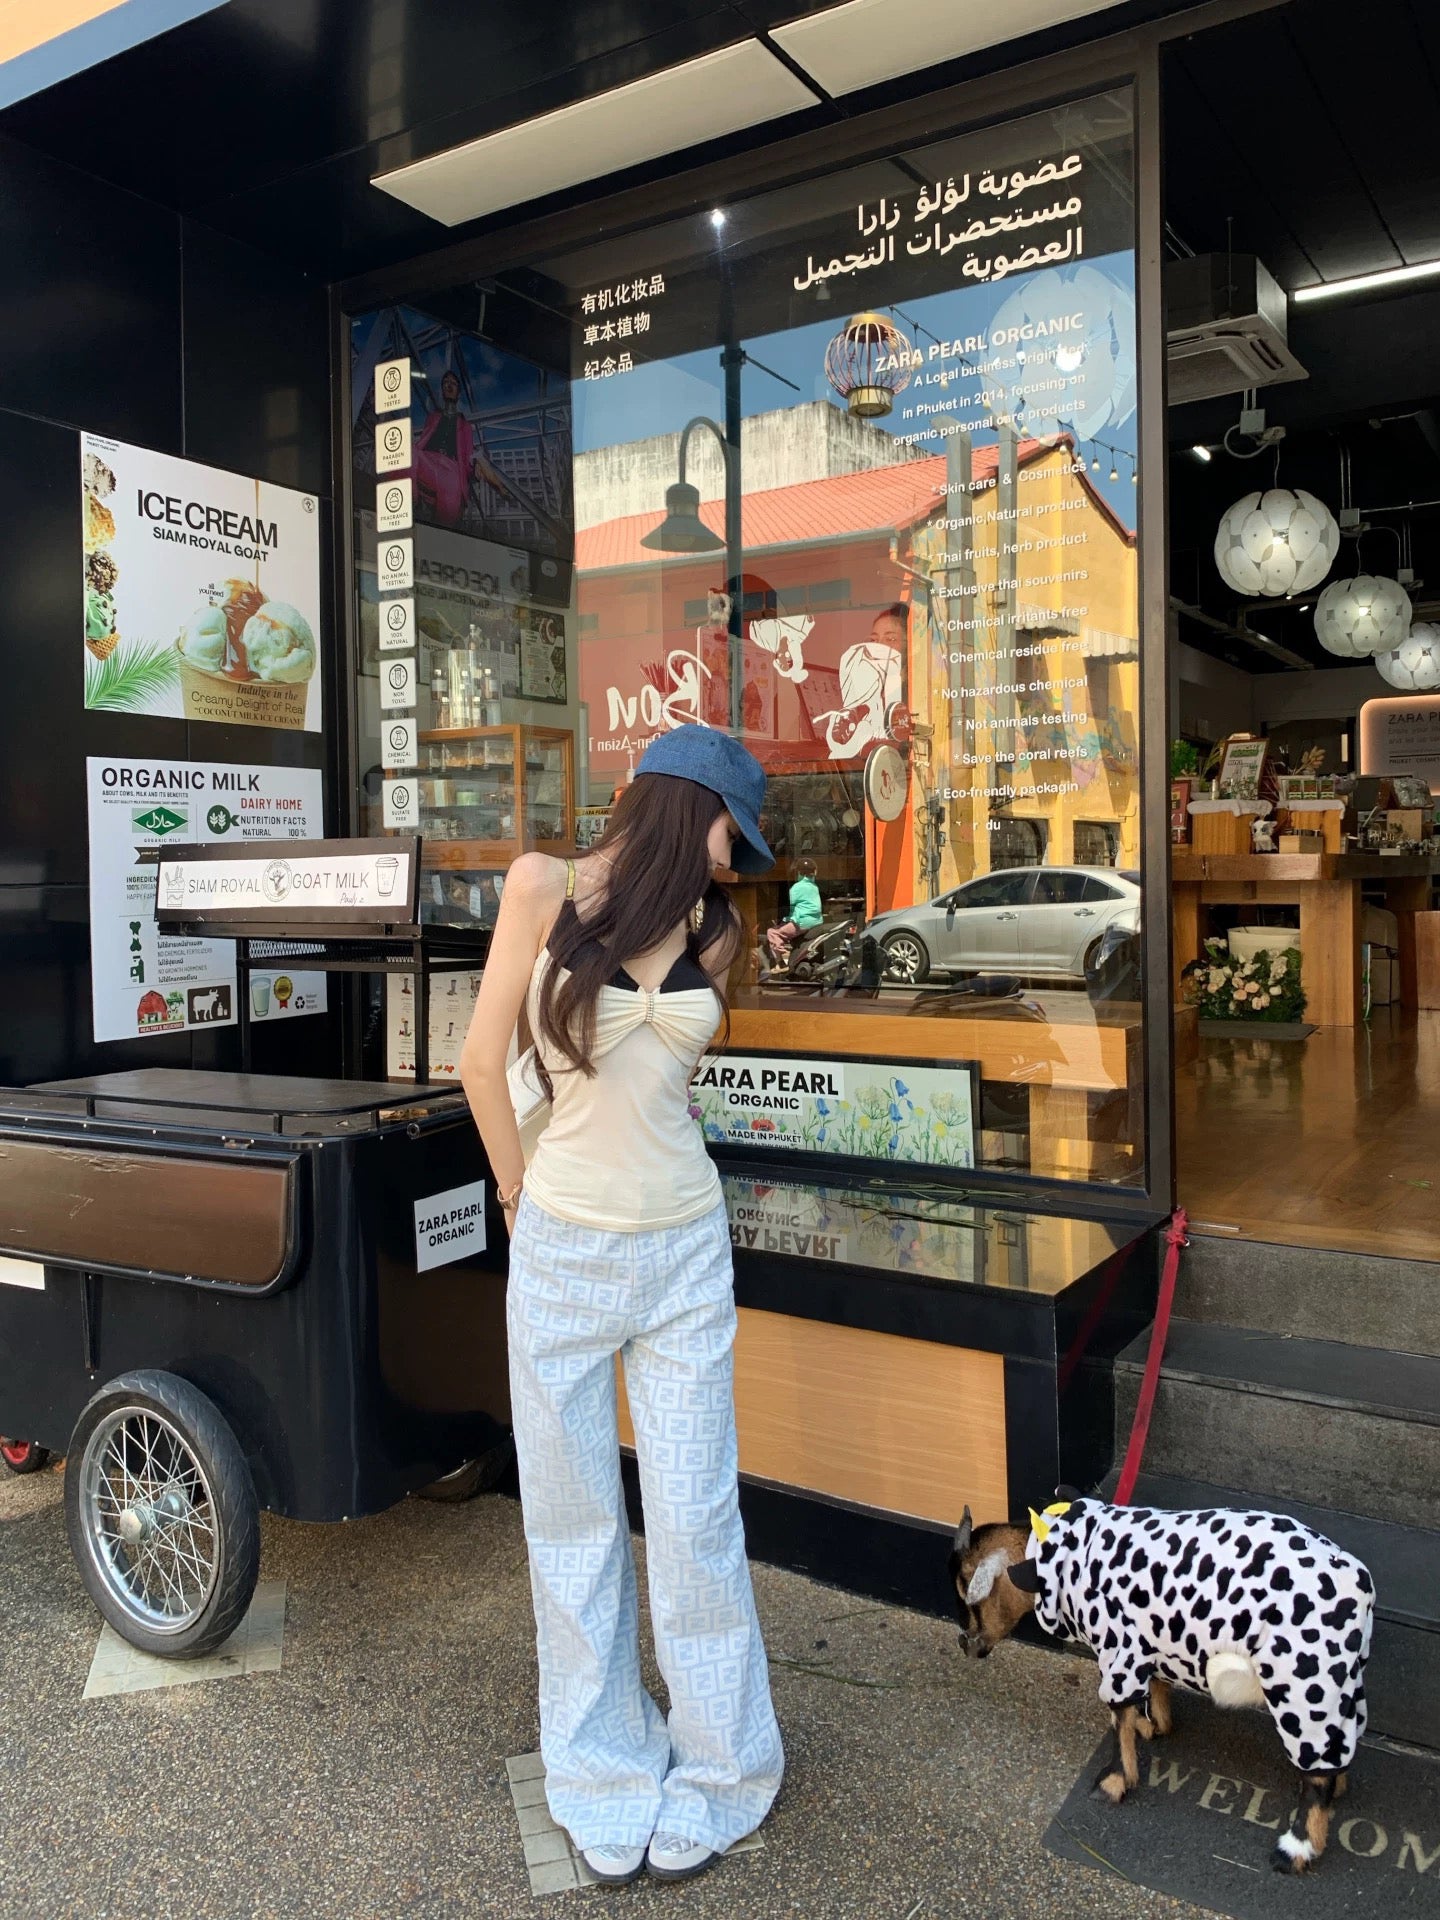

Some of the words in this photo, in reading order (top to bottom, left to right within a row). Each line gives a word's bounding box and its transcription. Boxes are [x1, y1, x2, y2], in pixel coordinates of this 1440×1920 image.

[914, 173, 970, 223] لؤلؤ
[858, 198, 900, 237] زارا
[906, 197, 1082, 256] مستحضرات
[793, 235, 895, 291] التجميل
[962, 226, 1083, 282] العضوية
[580, 273, 665, 315] 有机化妆品
[583, 311, 651, 346] 草本植物
[874, 348, 924, 373] ZARA
[929, 334, 988, 361] PEARL
[991, 312, 1084, 346] ORGANIC
[584, 352, 633, 381] 纪念品
[914, 376, 923, 388] A
[926, 369, 959, 385] Local
[961, 356, 1016, 377] business
[902, 407, 913, 420] in
[916, 398, 958, 417] Phuket
[960, 395, 971, 407] in
[1011, 377, 1066, 397] focusing
[1070, 374, 1085, 385] on
[893, 430, 937, 447] organic
[940, 418, 993, 438] personal
[1027, 400, 1086, 419] products
[939, 481, 966, 496] Skin
[968, 476, 996, 492] care
[1002, 473, 1012, 486] &
[1018, 462, 1087, 483] Cosmetics
[137, 489, 182, 526] ICE
[185, 502, 278, 549] CREAM
[1036, 497, 1088, 516] product
[153, 526, 187, 545] SIAM
[189, 535, 232, 555] ROYAL
[234, 545, 269, 562] GOAT
[936, 549, 962, 564] Thai
[964, 546, 1000, 562] fruits,
[1003, 539, 1033, 555] herb
[1036, 532, 1088, 551] product
[939, 581, 995, 599] Exclusive
[998, 575, 1022, 591] thai
[1025, 568, 1088, 587] souvenirs
[947, 613, 1004, 632] Chemical
[1007, 606, 1058, 625] irritants
[1061, 604, 1088, 618] free
[950, 648, 1007, 664] Chemical
[1010, 643, 1057, 658] residue
[237, 684, 270, 700] Indulge
[273, 689, 282, 698] in
[285, 690, 299, 701] the
[942, 687, 958, 700] No
[961, 679, 1026, 698] hazardous
[1029, 675, 1088, 692] chemical
[191, 691, 233, 709] Creamy
[272, 702, 284, 711] of
[285, 706, 305, 715] Real
[239, 711, 260, 720] MILK
[260, 714, 272, 722] ICE
[966, 717, 988, 731] Not
[990, 714, 1039, 729] animals
[1042, 711, 1087, 725] testing
[1388, 712, 1424, 725] ZARA
[962, 751, 992, 765] Save
[995, 750, 1015, 763] the
[1018, 748, 1051, 762] coral
[1054, 746, 1088, 758] reefs
[102, 767, 205, 789] ORGANIC
[212, 772, 260, 792] MILK
[241, 797, 271, 810] DAIRY
[276, 799, 302, 811] HOME
[145, 811, 175, 829] حلال
[240, 815, 281, 825] NUTRITION
[283, 817, 307, 825] FACTS
[242, 828, 271, 836] NATURAL
[188, 879, 217, 894] SIAM
[221, 877, 261, 893] ROYAL
[292, 872, 331, 889] GOAT
[335, 871, 370, 889] MILK
[761, 1069, 839, 1096] PEARL
[728, 1093, 800, 1110] ORGANIC
[727, 1129, 756, 1140] MADE
[757, 1132, 767, 1140] IN
[769, 1133, 802, 1143] PHUKET
[418, 1213, 449, 1234] ZARA
[450, 1202, 482, 1224] PEARL
[428, 1222, 475, 1247] ORGANIC
[1148, 1756, 1440, 1874] WELOM
